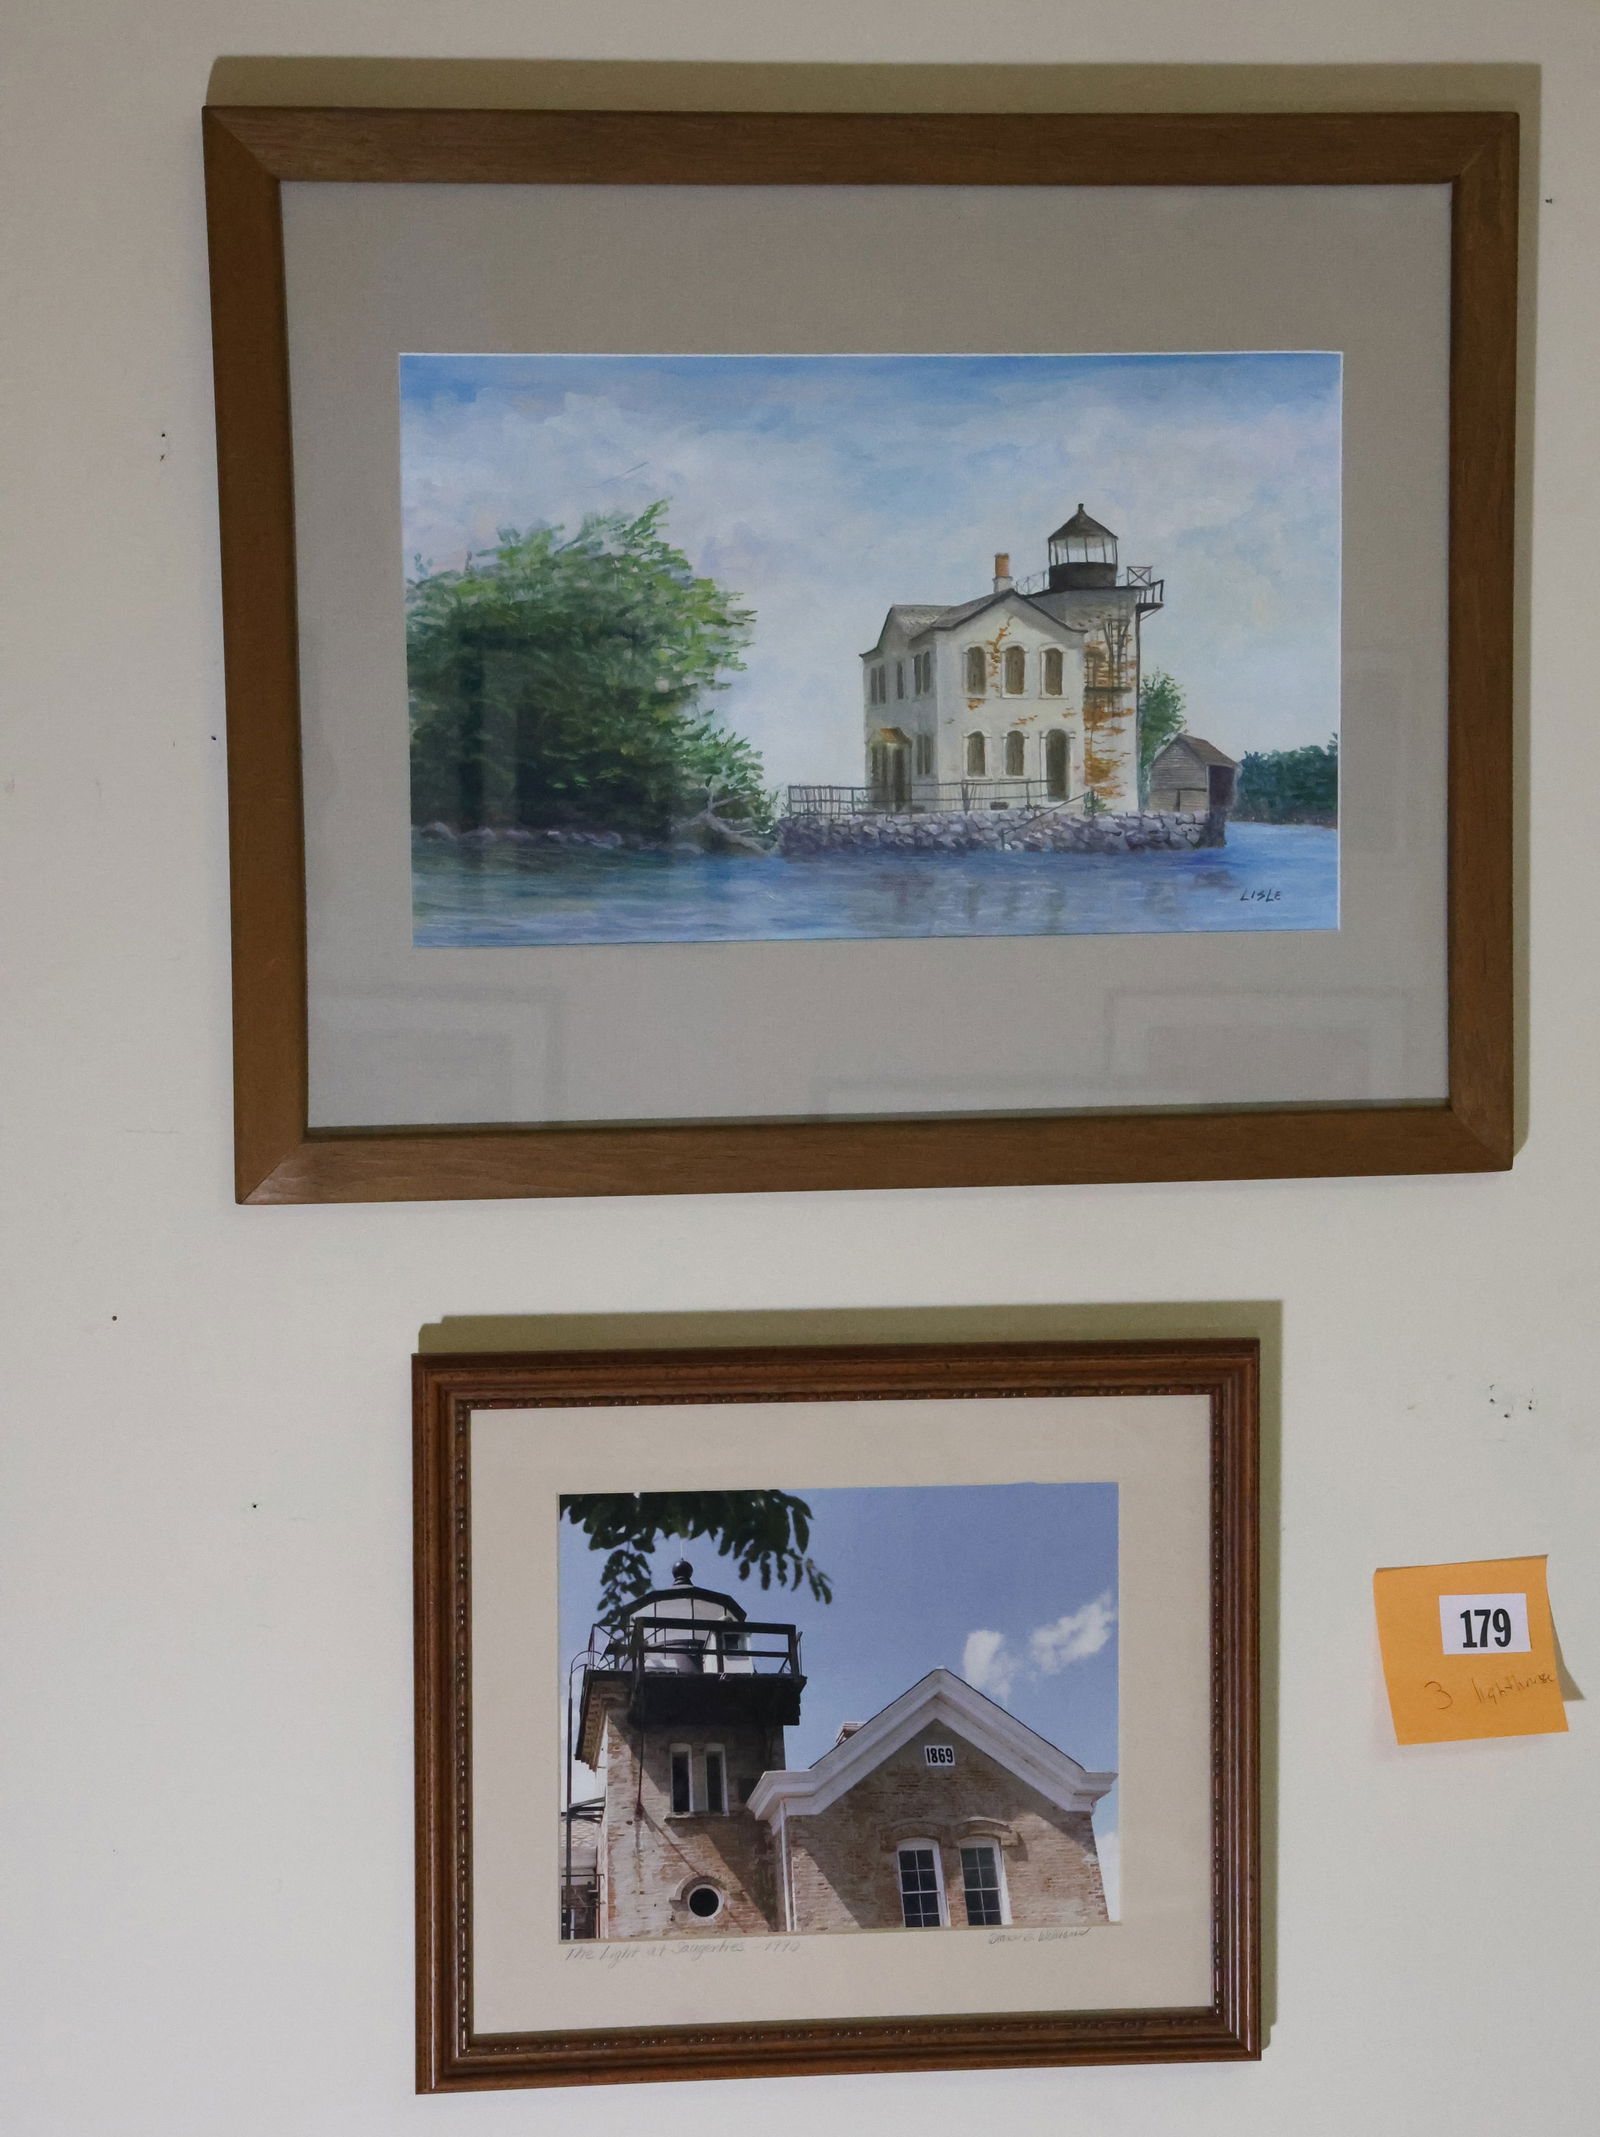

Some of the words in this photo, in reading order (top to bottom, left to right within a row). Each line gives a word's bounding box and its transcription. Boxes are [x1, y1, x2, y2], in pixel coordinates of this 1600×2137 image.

[1240, 888, 1282, 903] LISLE
[1460, 1608, 1512, 1649] 179
[1424, 1680, 1454, 1710] 3
[926, 1747, 954, 1764] 1869
